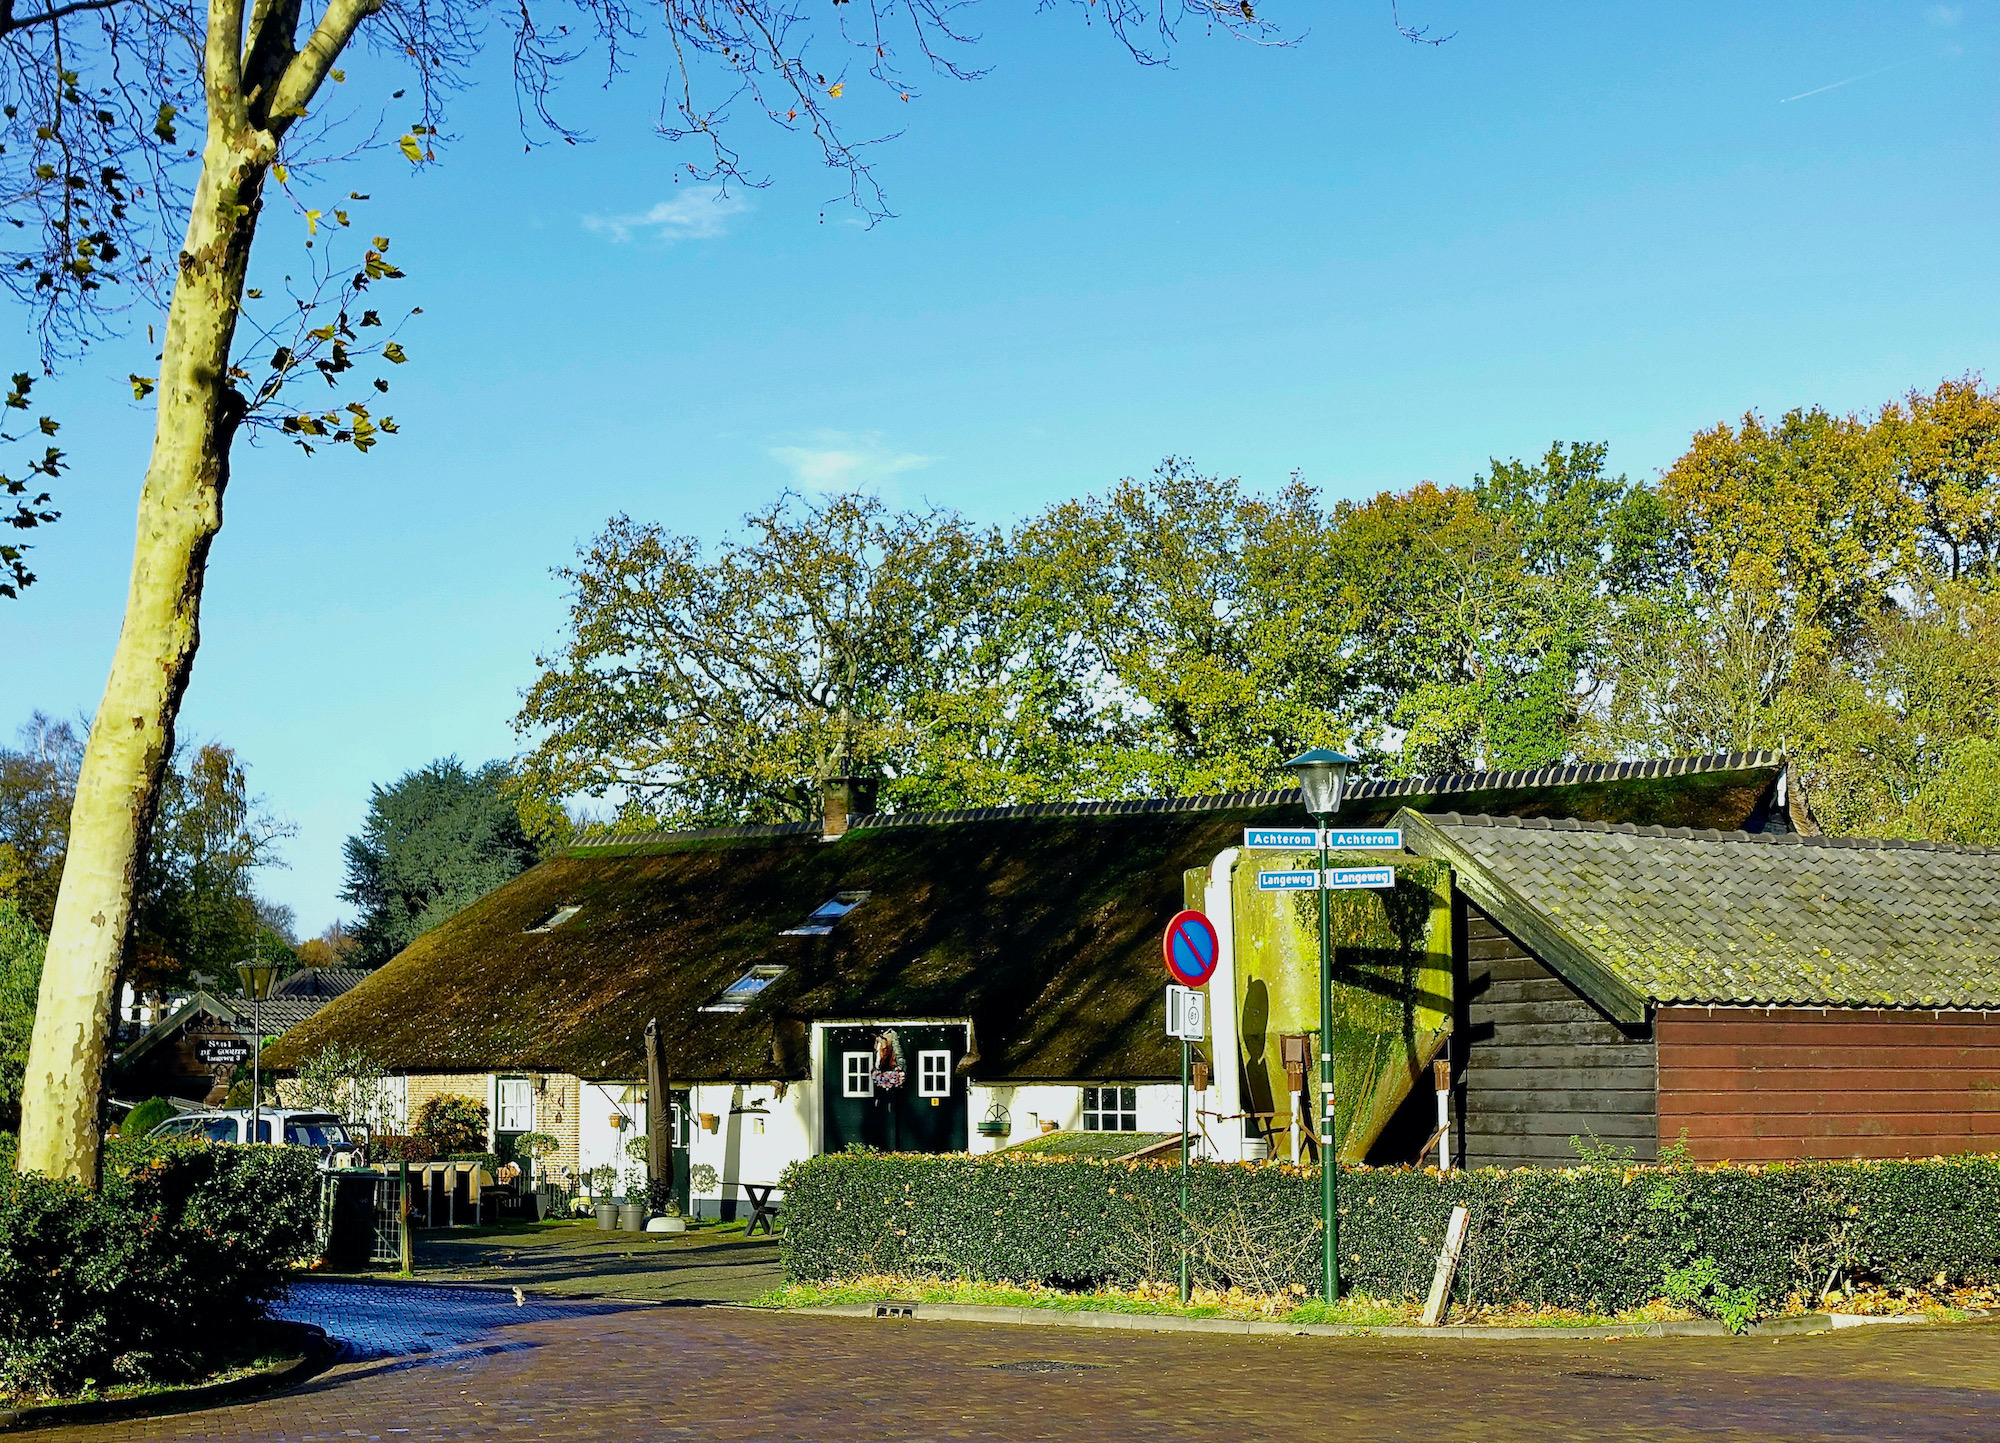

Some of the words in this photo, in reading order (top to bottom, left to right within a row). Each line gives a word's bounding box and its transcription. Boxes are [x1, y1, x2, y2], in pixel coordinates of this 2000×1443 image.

[1254, 833, 1312, 845] Achterom
[1337, 833, 1395, 845] Achterom
[1262, 874, 1313, 887] Langeweg
[1334, 872, 1388, 884] Langeweg
